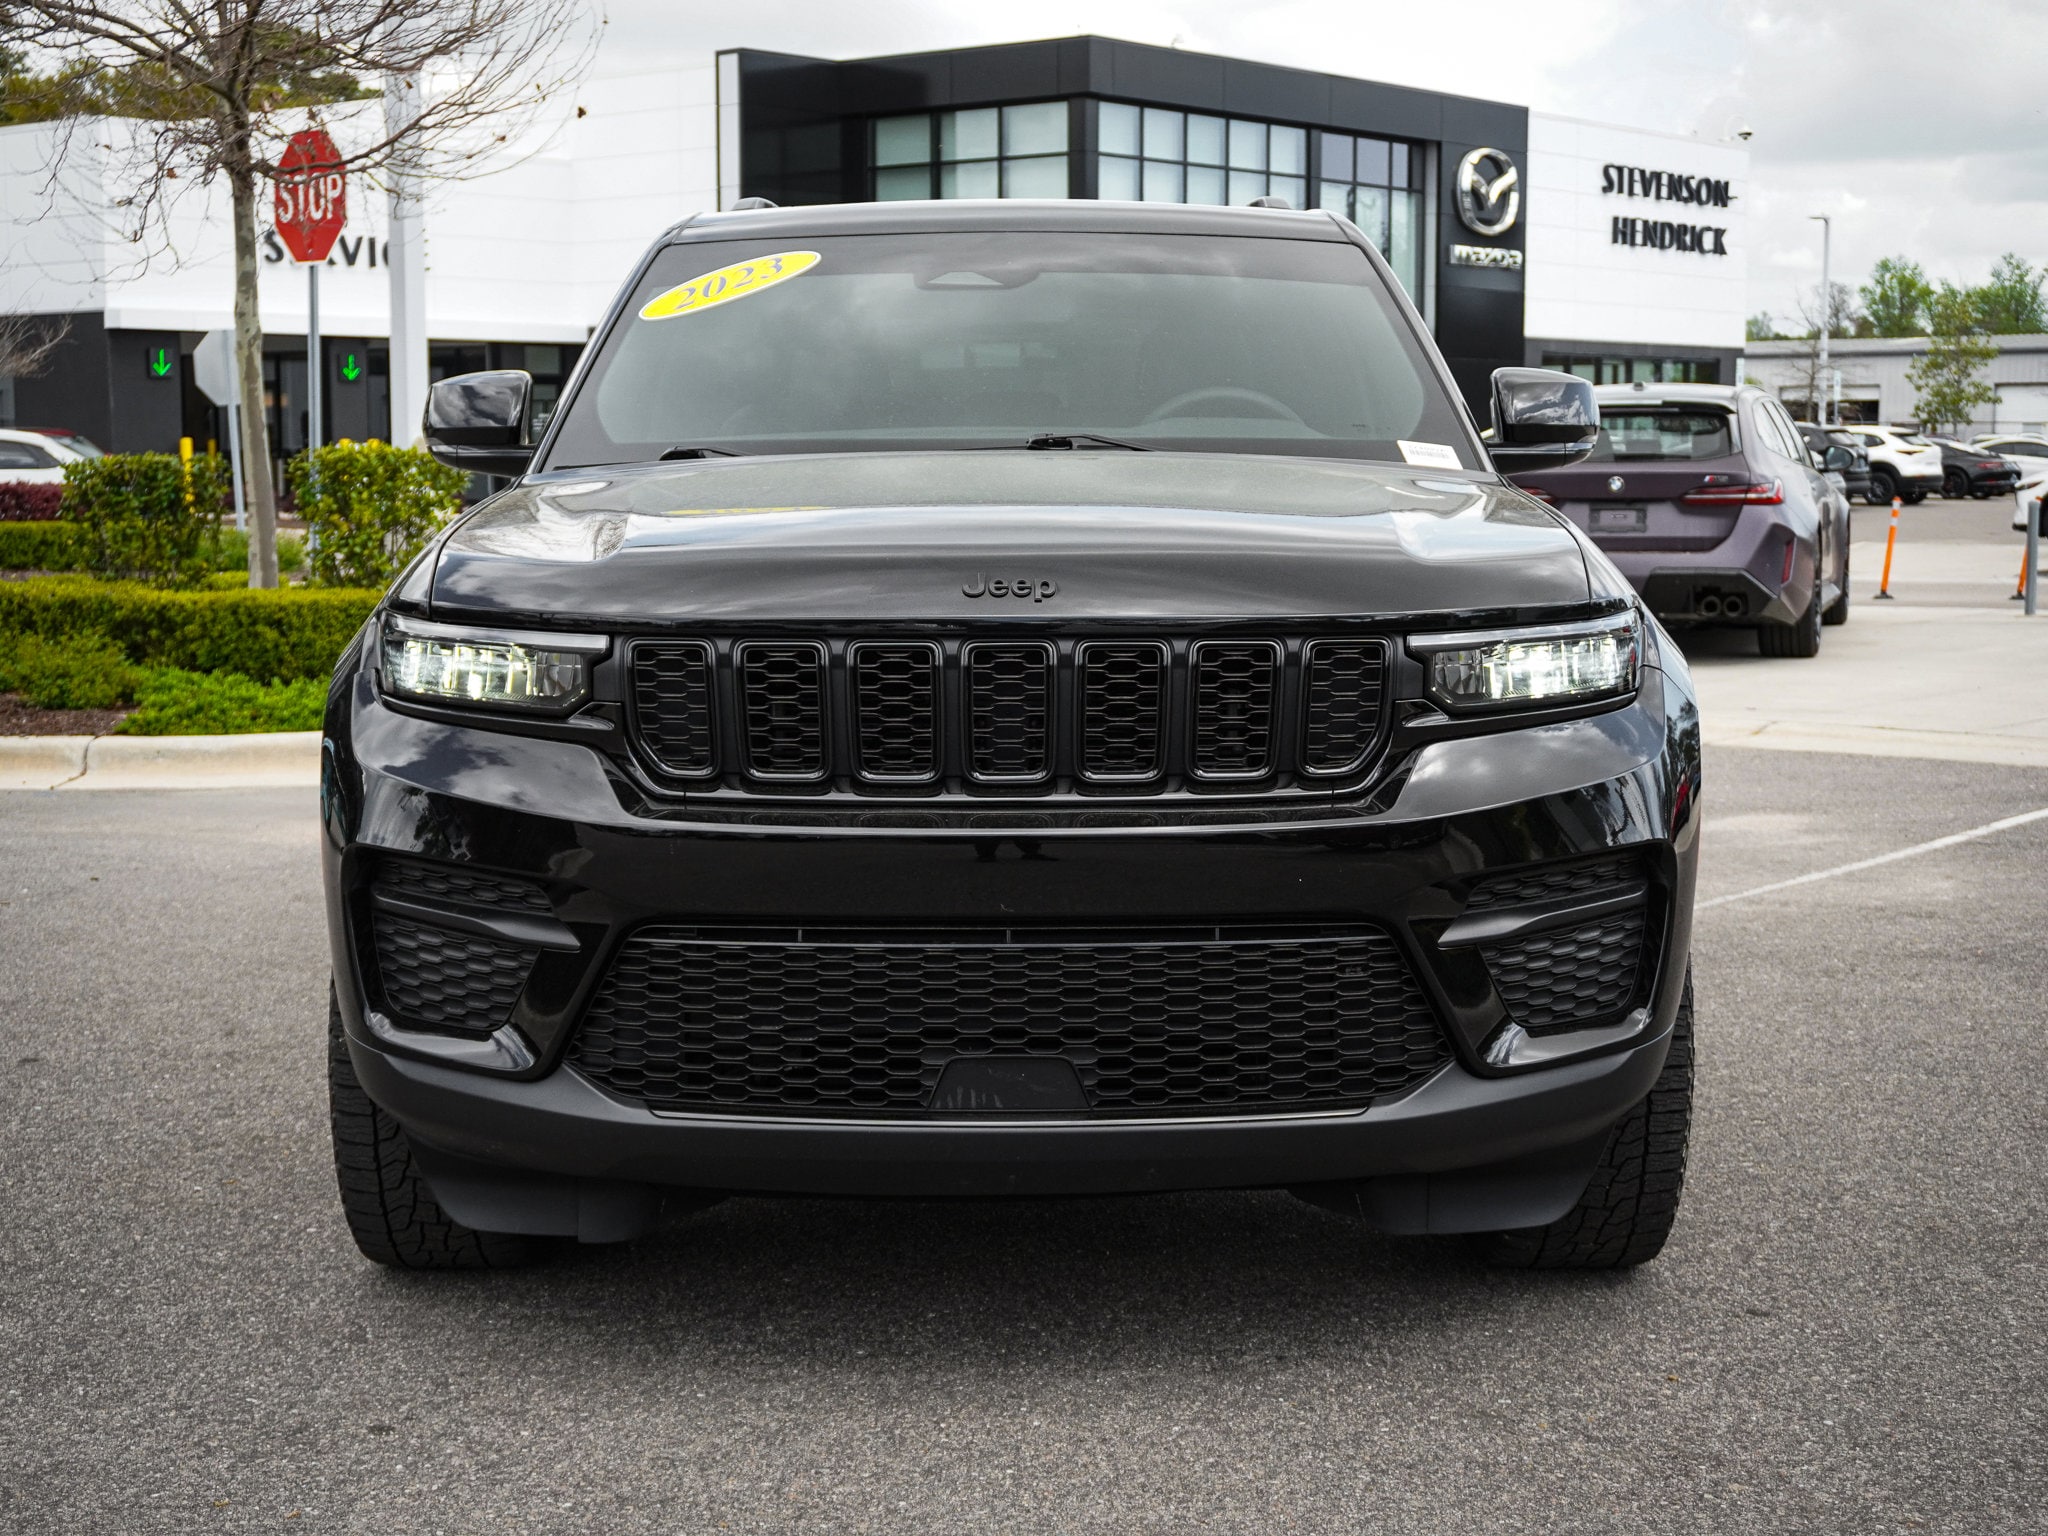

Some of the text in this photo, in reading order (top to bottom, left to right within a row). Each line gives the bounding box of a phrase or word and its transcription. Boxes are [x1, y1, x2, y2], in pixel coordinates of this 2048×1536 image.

[277, 172, 343, 223] STOP
[1611, 216, 1728, 255] HENDRICK
[674, 256, 783, 310] 2023
[961, 571, 1057, 603] Jeep
